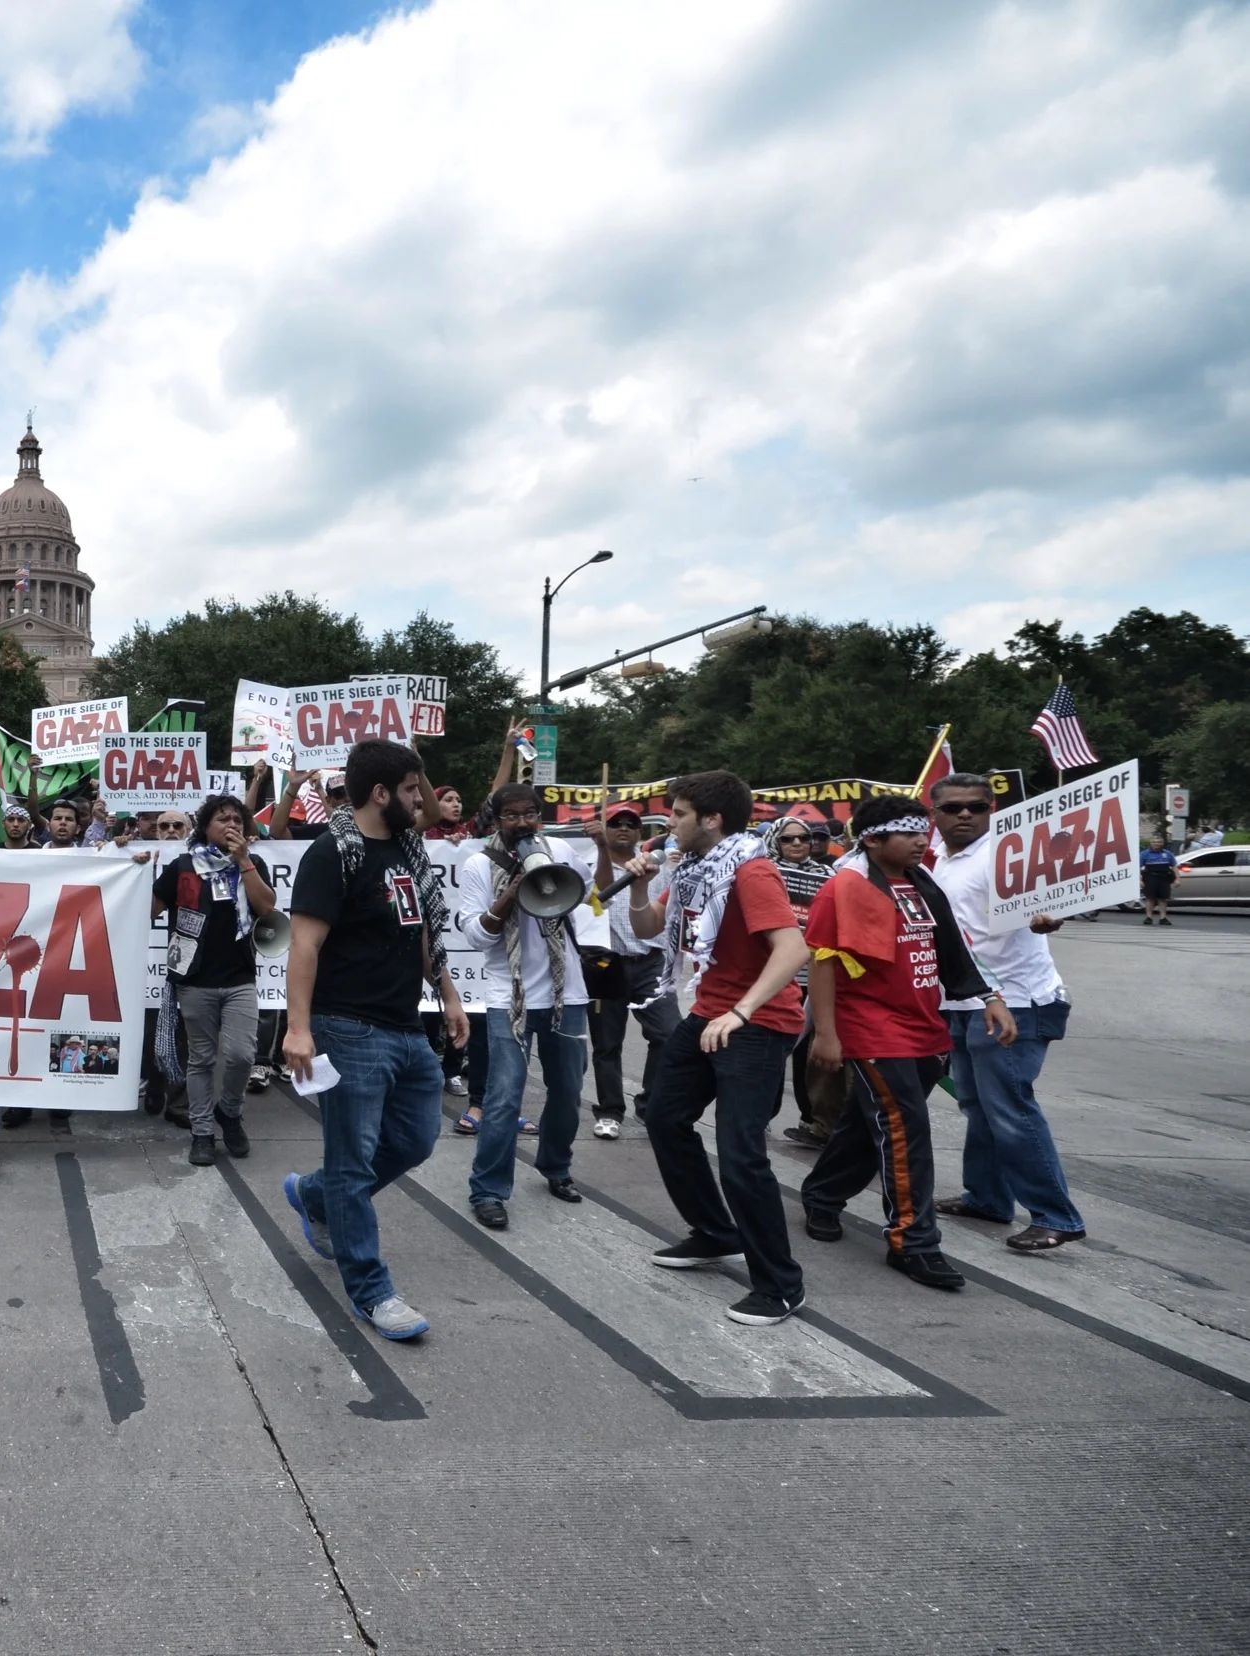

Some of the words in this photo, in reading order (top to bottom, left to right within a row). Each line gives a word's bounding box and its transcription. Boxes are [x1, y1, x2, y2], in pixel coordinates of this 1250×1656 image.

[248, 692, 278, 706] END
[295, 691, 318, 703] END
[323, 688, 345, 701] THE
[349, 685, 383, 699] SIEGE
[386, 683, 402, 695] OF
[36, 710, 55, 720] END
[58, 706, 77, 717] THE
[79, 702, 108, 714] SIEGE
[111, 700, 124, 710] OF
[36, 710, 122, 751] GAZA
[296, 697, 408, 748] GAZA
[105, 737, 126, 748] END
[129, 737, 150, 748] THE
[153, 737, 184, 748] SIEGE
[187, 736, 202, 748] OF
[280, 742, 295, 753] IN
[271, 752, 294, 767] GAZ
[300, 747, 323, 758] STOP
[325, 745, 341, 756] U.S.
[105, 749, 202, 791] GAZA
[104, 792, 125, 800] STOP
[127, 792, 141, 800] U.S.
[143, 792, 158, 800] AID
[160, 792, 172, 800] TO
[174, 792, 202, 800] ISRAEL
[544, 786, 610, 803] STOP
[618, 781, 668, 801] THE
[996, 812, 1022, 836] END
[1027, 799, 1053, 824] THE
[1058, 780, 1103, 812] SIEGE
[1108, 770, 1131, 793] OF
[994, 796, 1132, 900] GAZA
[994, 900, 1021, 916] STOP
[1023, 894, 1042, 908] U.S.
[1044, 886, 1065, 903] AID
[1067, 880, 1086, 895] TO
[1088, 868, 1132, 890] ISRAEL
[919, 940, 930, 948] WE
[914, 963, 938, 976] KEEP
[913, 975, 939, 989] CALM
